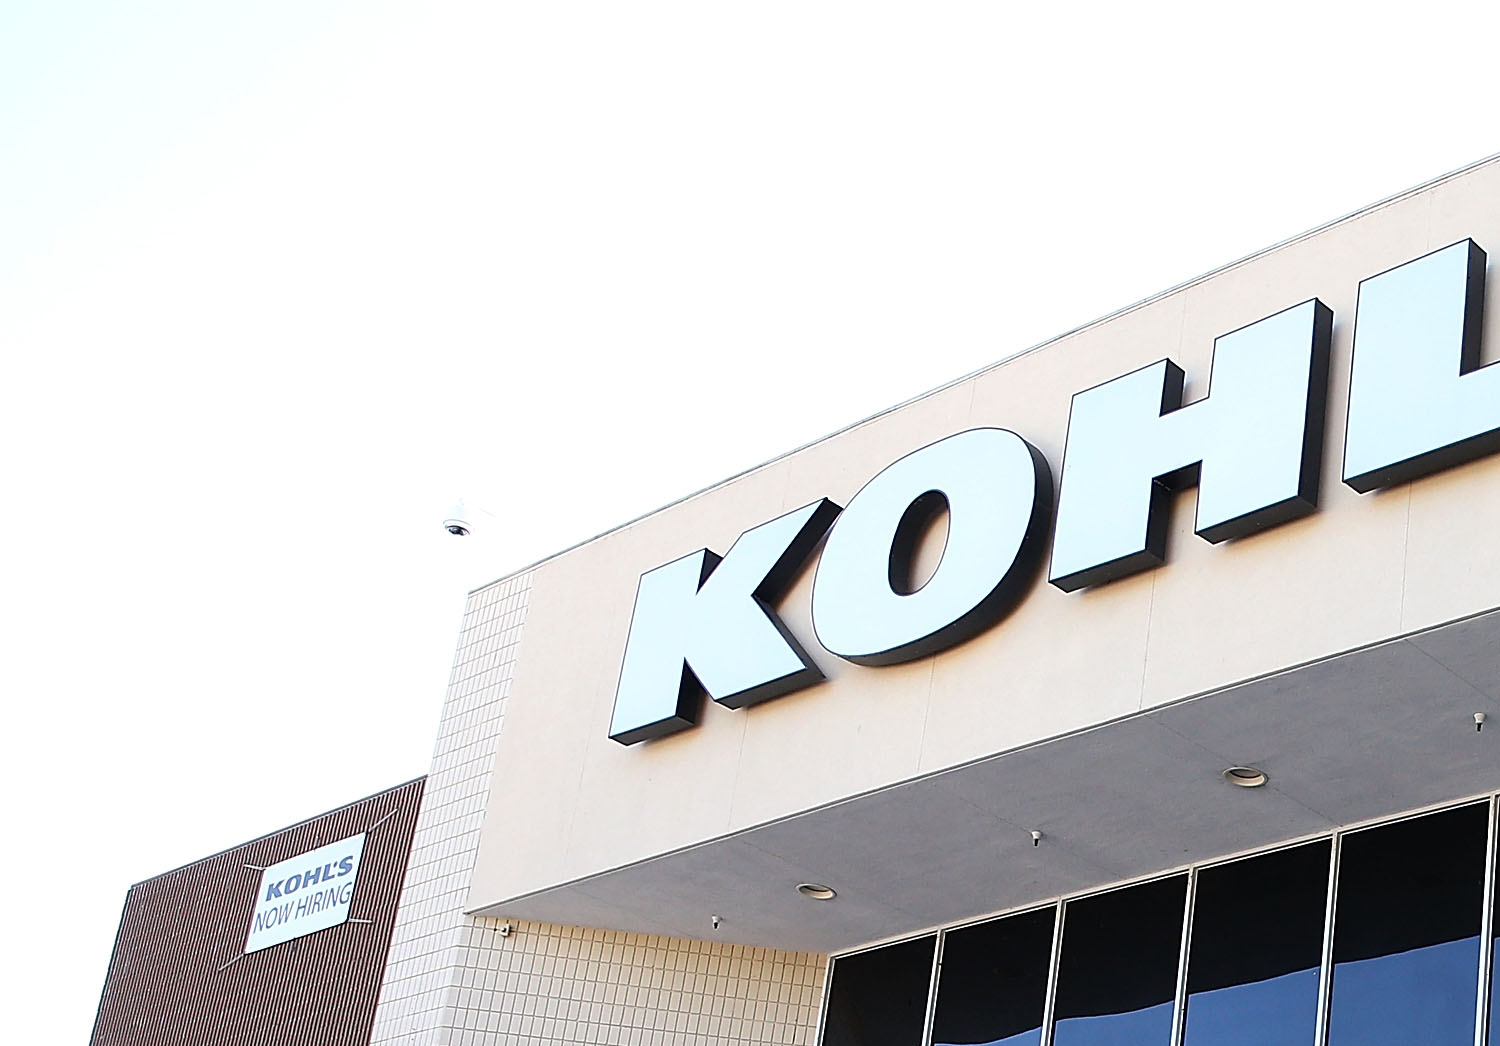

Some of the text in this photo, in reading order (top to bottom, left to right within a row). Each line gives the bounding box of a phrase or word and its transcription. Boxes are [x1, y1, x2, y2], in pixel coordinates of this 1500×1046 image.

[265, 855, 354, 902] KOHL'S
[252, 881, 353, 934] NOW HIRING
